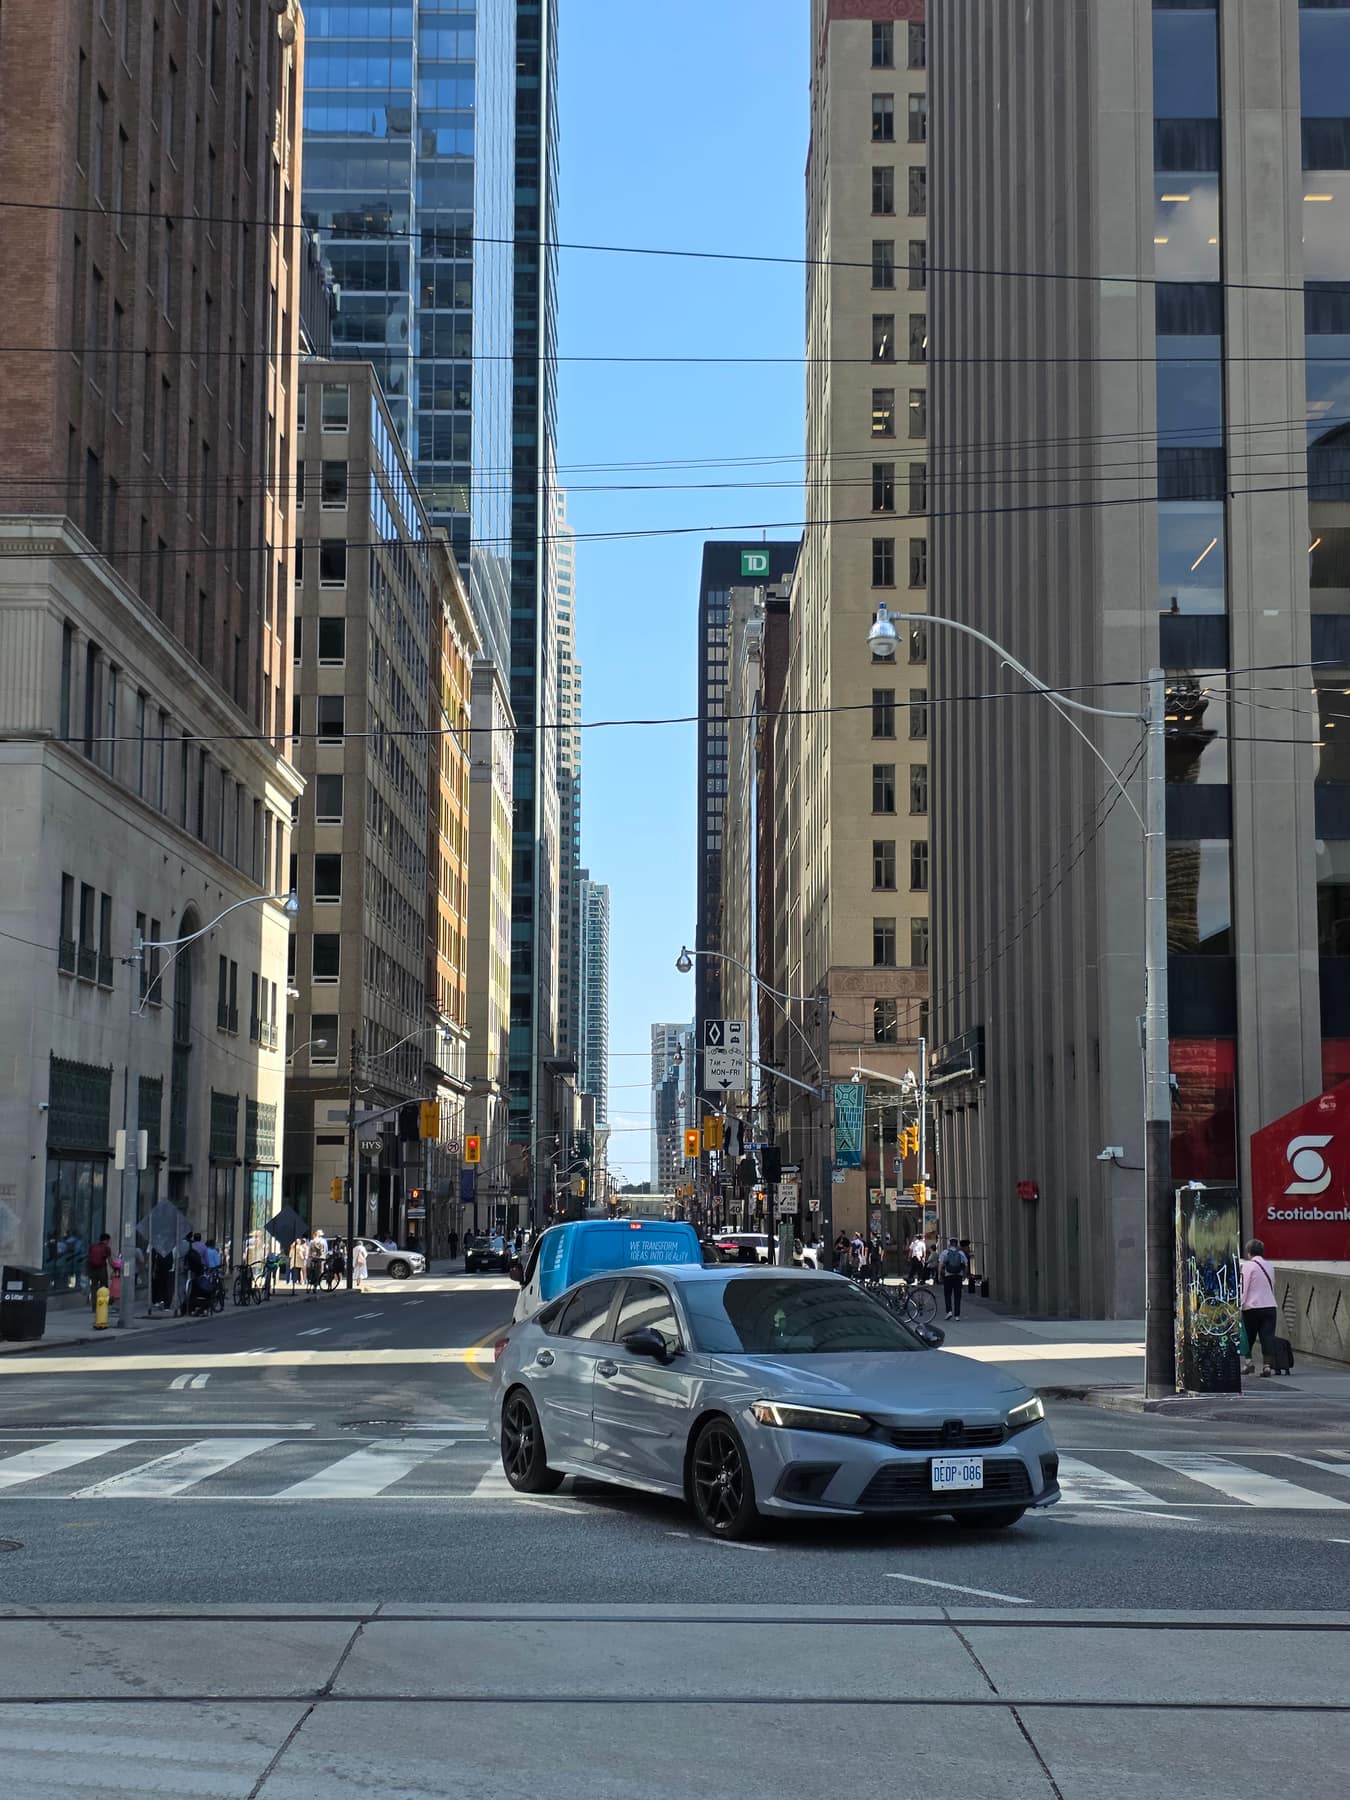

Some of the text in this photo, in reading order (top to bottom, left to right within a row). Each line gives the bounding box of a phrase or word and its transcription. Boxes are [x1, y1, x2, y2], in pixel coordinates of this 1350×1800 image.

[744, 555, 767, 571] TD
[361, 1141, 381, 1149] HY'S
[630, 1240, 678, 1251] WE TRANSFORM
[630, 1251, 689, 1262] IDEAS INTO REALITY
